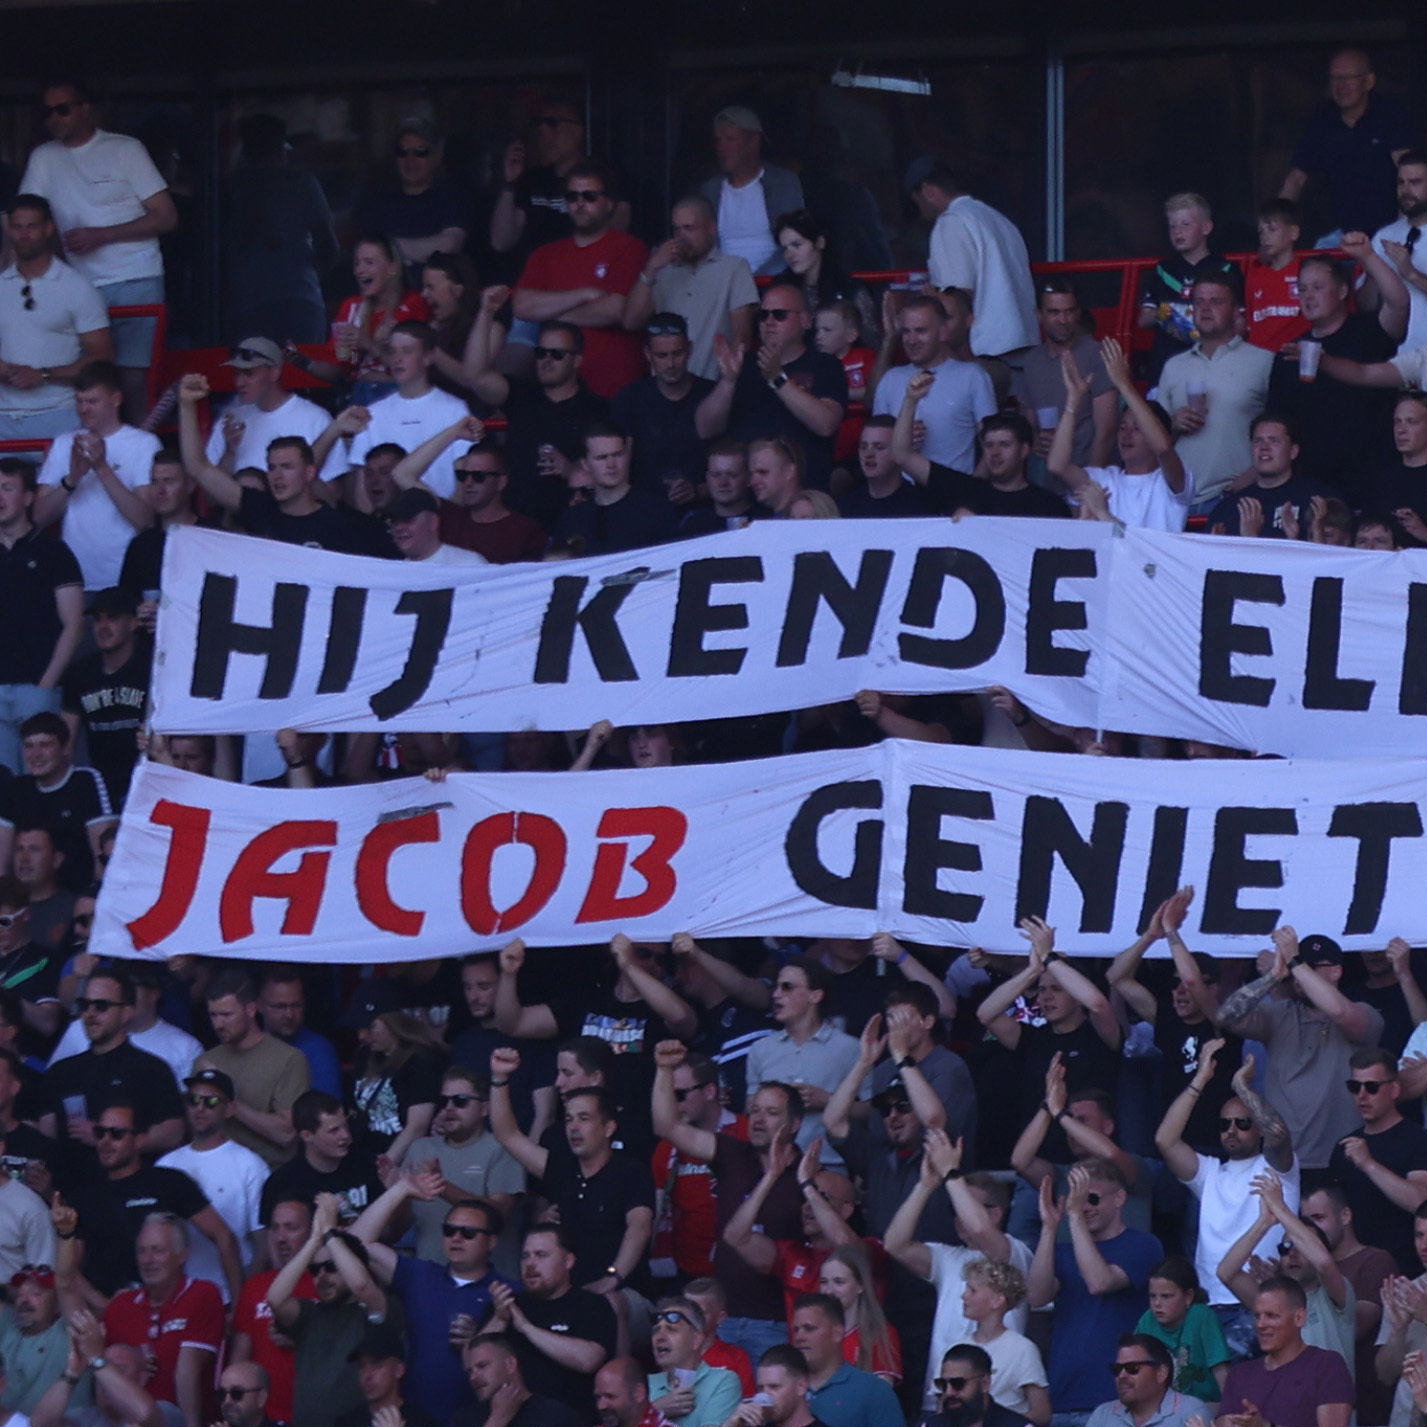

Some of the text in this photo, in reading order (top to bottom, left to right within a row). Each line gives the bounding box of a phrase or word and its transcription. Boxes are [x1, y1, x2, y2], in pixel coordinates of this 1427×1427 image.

[191, 572, 454, 721] HIJ
[534, 547, 1097, 684] KENDE
[126, 796, 688, 949] JACOB
[785, 779, 1424, 935] GENIET
